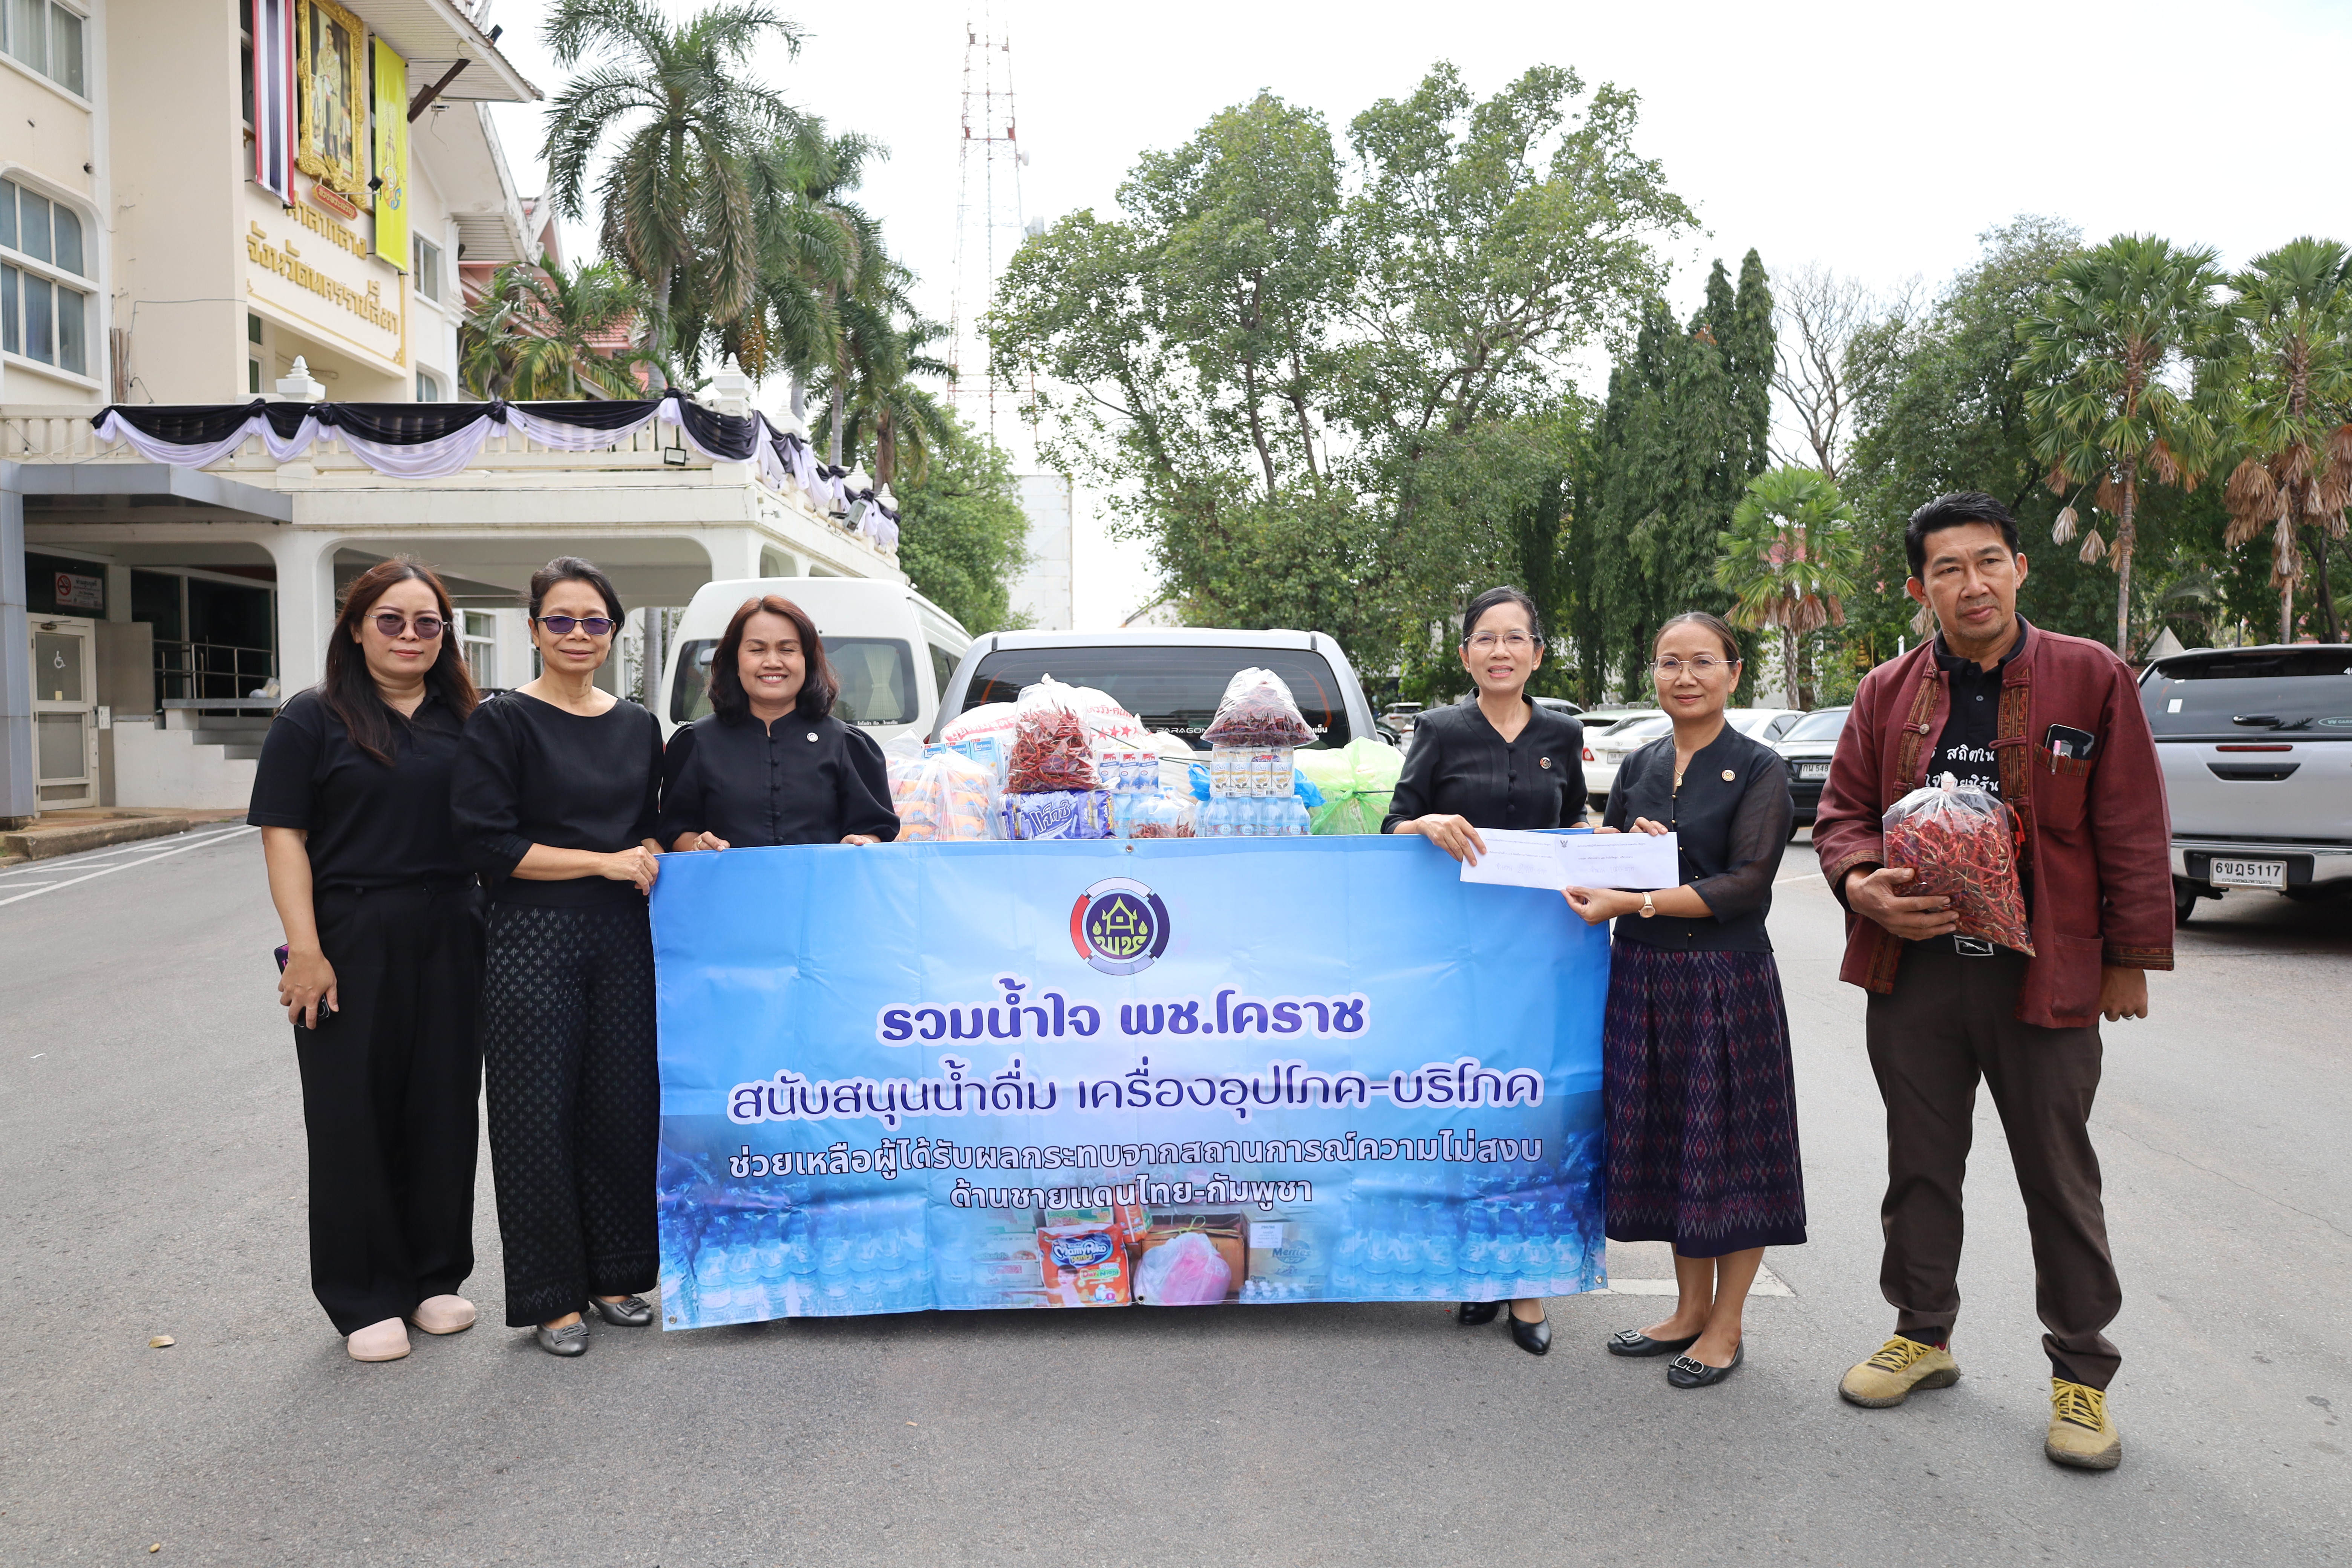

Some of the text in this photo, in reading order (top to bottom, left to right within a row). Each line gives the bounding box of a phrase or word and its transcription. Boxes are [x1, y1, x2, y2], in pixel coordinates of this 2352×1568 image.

[247, 220, 400, 335] จังหวัดนครราชสีมา
[974, 743, 991, 751] Lactasoy
[1946, 744, 1995, 763] สถิตใน
[2247, 864, 2281, 877] 5117
[882, 977, 1363, 1040] รวมน้ำใจ พช.โคราช
[733, 1055, 1538, 1126] สนับสนุนน้ำดื่ม เครื่องอุปโภค-บริโภค
[729, 1129, 1543, 1180] ช่วยเหลือผู้ได้รับผลกระทบจากสถานการณ์ความไม่สงบ
[950, 1173, 1312, 1211] ด้านชายแดนไทย-กัมพูชา
[1272, 1246, 1311, 1258] Merries
